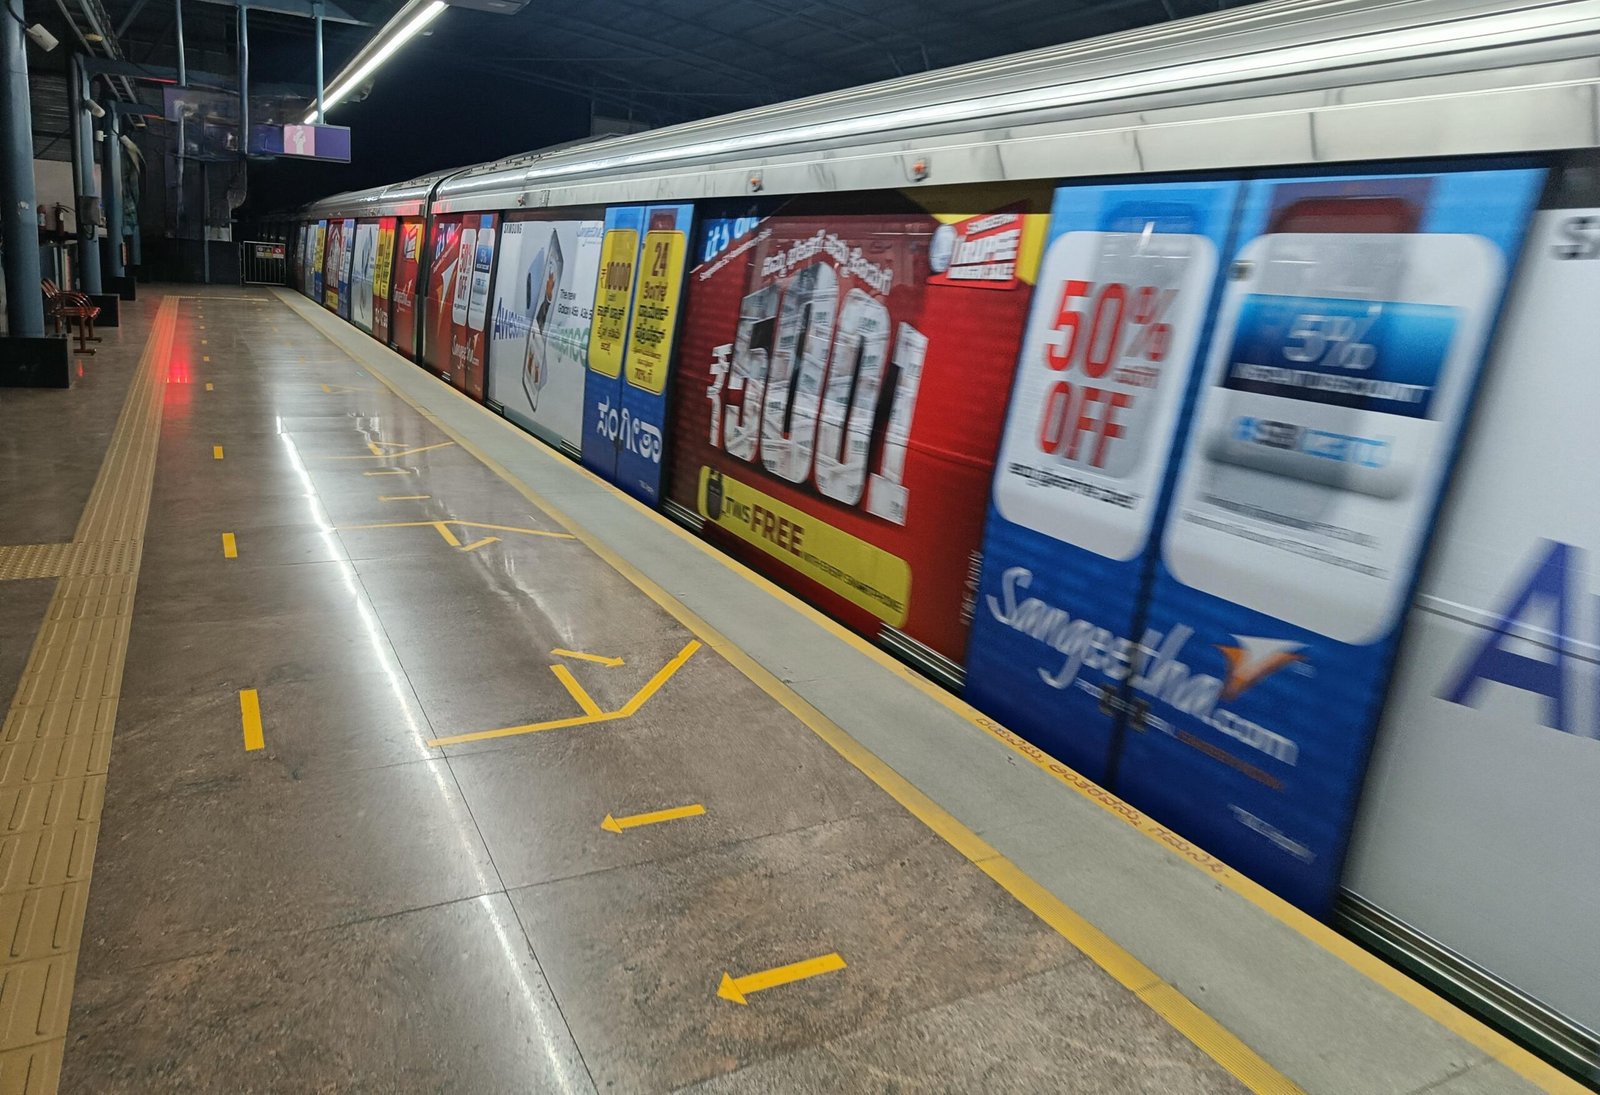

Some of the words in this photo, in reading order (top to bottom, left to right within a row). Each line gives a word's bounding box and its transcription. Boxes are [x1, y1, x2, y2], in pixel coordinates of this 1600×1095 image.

[652, 241, 671, 277] 24
[1044, 279, 1180, 378] 50%
[1037, 380, 1134, 469] OFF
[725, 496, 750, 523] TWS
[751, 503, 804, 557] FREE
[976, 718, 1043, 763] ದಯವಿಟ್ಟು
[1049, 764, 1142, 826] ಅಂತರವನ್ನು
